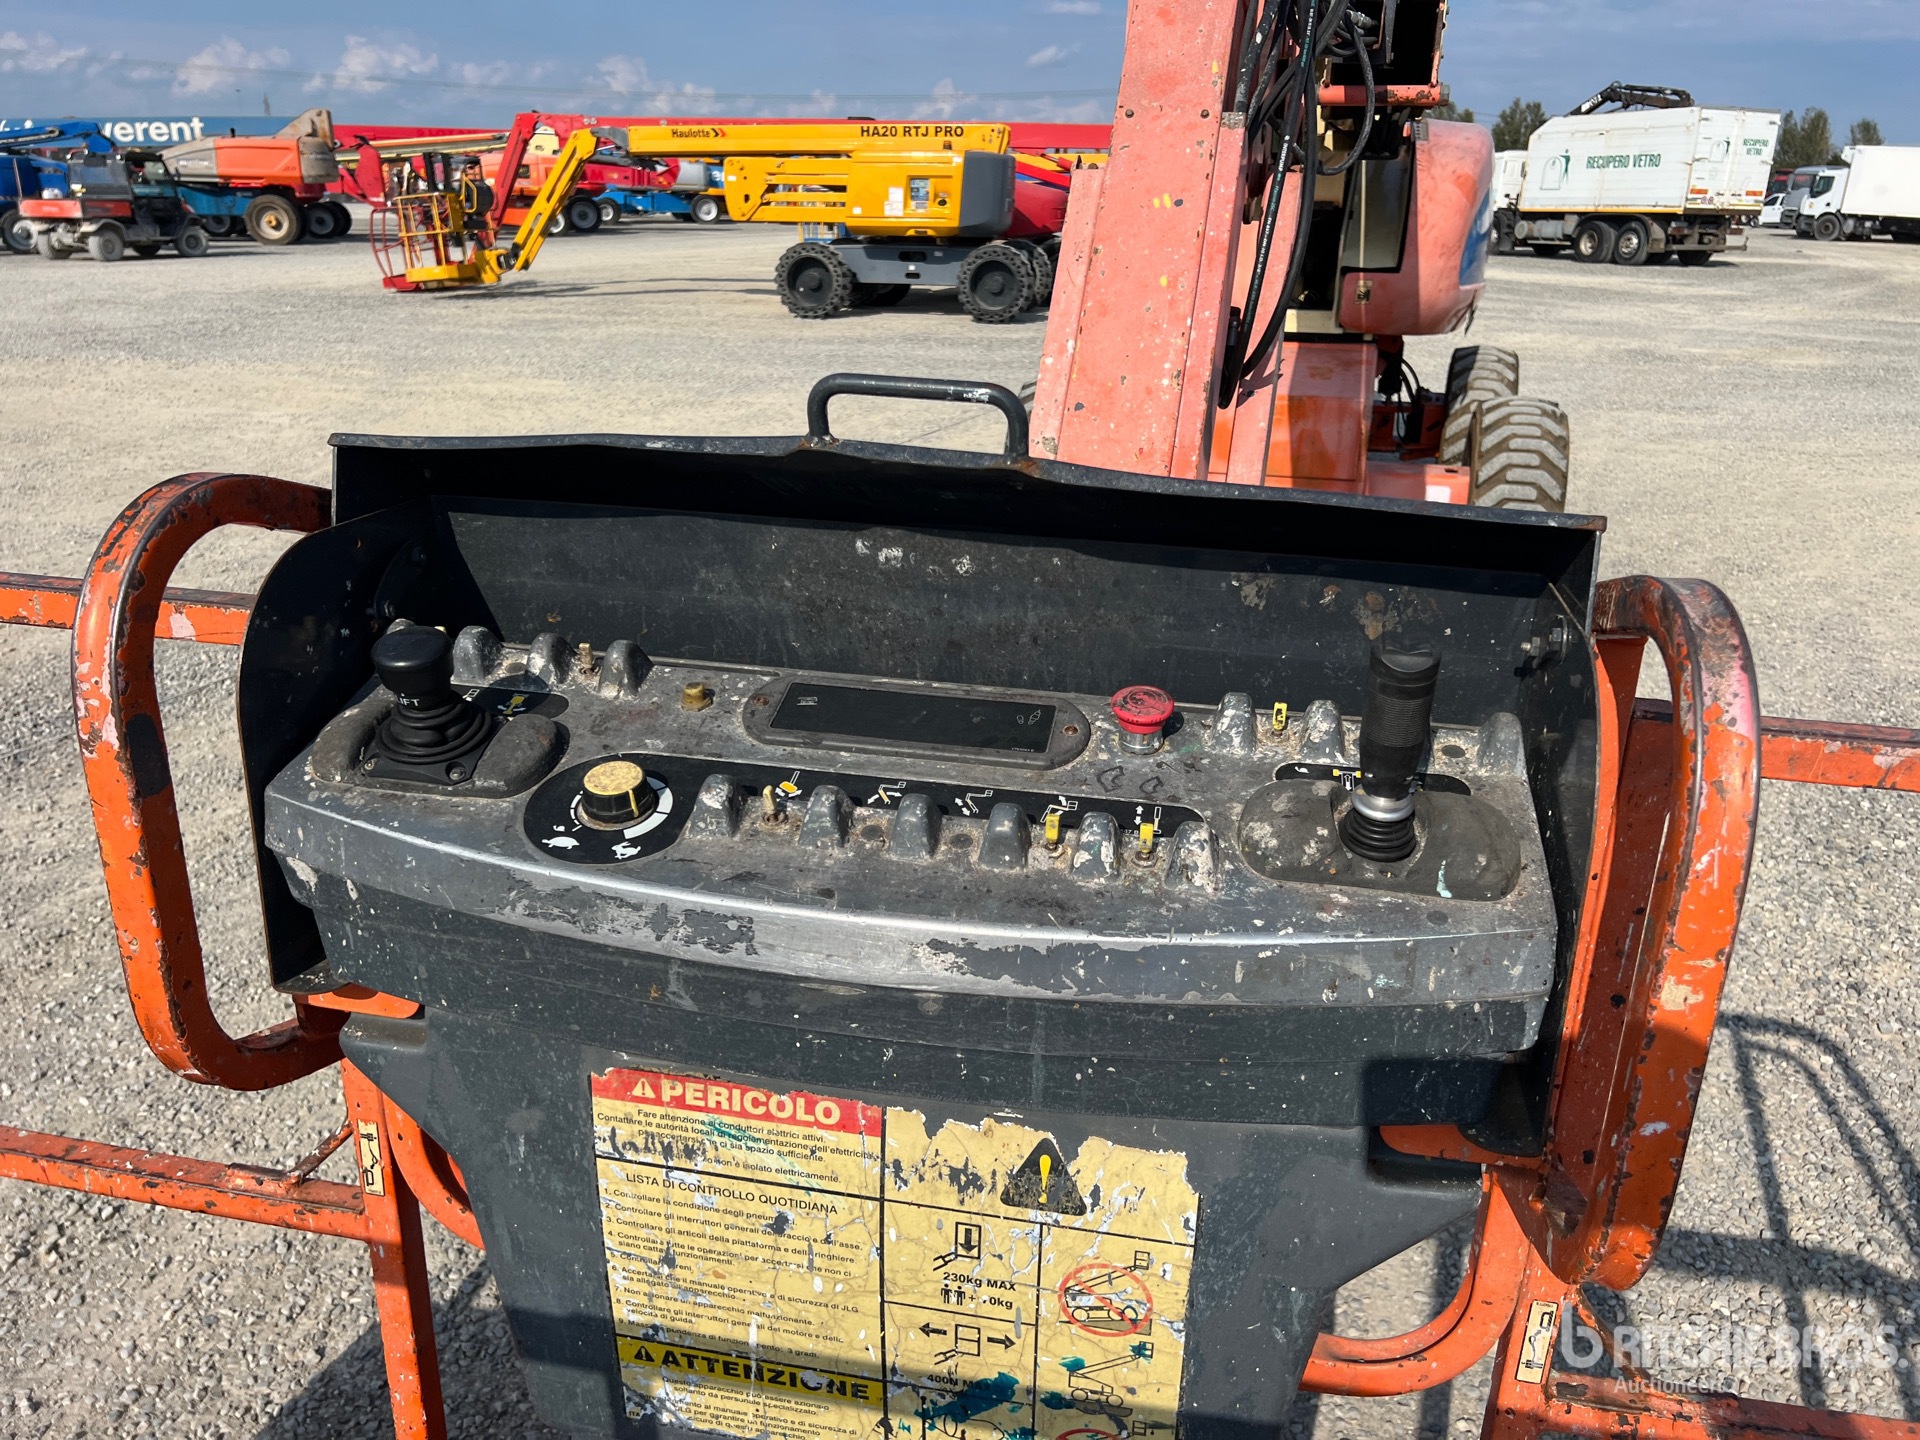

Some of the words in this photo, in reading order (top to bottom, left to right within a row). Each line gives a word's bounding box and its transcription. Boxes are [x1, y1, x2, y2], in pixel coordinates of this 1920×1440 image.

[671, 128, 710, 138] Haulotte
[861, 126, 898, 137] HA20
[903, 126, 929, 137] RTJ
[935, 126, 964, 137] PRO
[1743, 138, 1770, 147] RECUPERO
[1586, 155, 1630, 169] RECUPERO
[1633, 153, 1661, 168] VETRO
[398, 697, 420, 707] IFT
[662, 1079, 841, 1126] PERICOLO
[596, 1112, 643, 1126] Contattare
[644, 1119, 653, 1127] le
[654, 1120, 689, 1133] autorità
[690, 1125, 714, 1136] locali
[637, 1108, 657, 1118] Fare
[658, 1112, 706, 1126] attenzione
[718, 1120, 764, 1134] conduttori
[801, 1132, 825, 1143] attivi.
[719, 1140, 727, 1148] ci
[729, 1141, 743, 1150] sia
[776, 1148, 825, 1163] sufficiente.
[774, 1166, 841, 1183] elettricamente.
[604, 1187, 611, 1195] 1.
[672, 1199, 720, 1213] condizione
[721, 1206, 744, 1218] degli
[625, 1172, 659, 1186] LISTA
[662, 1178, 674, 1188] DI
[677, 1181, 755, 1201] CONTROLLO
[758, 1193, 838, 1214] QUOTIDIANA
[614, 1202, 662, 1217] Controllare
[663, 1211, 675, 1221] gli
[675, 1213, 721, 1228] interruttori
[606, 1215, 613, 1223] 3.
[615, 1217, 663, 1232] Controllare
[664, 1226, 676, 1235] gli
[676, 1228, 706, 1239] articoli
[708, 1233, 730, 1243] della
[731, 1237, 781, 1252] piattaforma
[790, 1247, 811, 1257] dell
[617, 1239, 641, 1249] siano
[686, 1243, 695, 1251] le
[823, 1267, 842, 1275] non
[843, 1269, 851, 1277] ci
[623, 1286, 640, 1295] Non
[943, 1271, 982, 1288] 230kg
[987, 1277, 1017, 1292] MAX
[624, 1299, 671, 1314] Controllare
[672, 1308, 683, 1317] gli
[776, 1293, 785, 1301] di
[787, 1295, 828, 1308] sicurezza
[830, 1302, 839, 1310] di
[840, 1304, 858, 1313] JLG
[981, 1296, 1013, 1310] 0kg
[659, 1350, 869, 1400] ATTENZIONE
[628, 1409, 640, 1417] ITA
[797, 1419, 805, 1427] di
